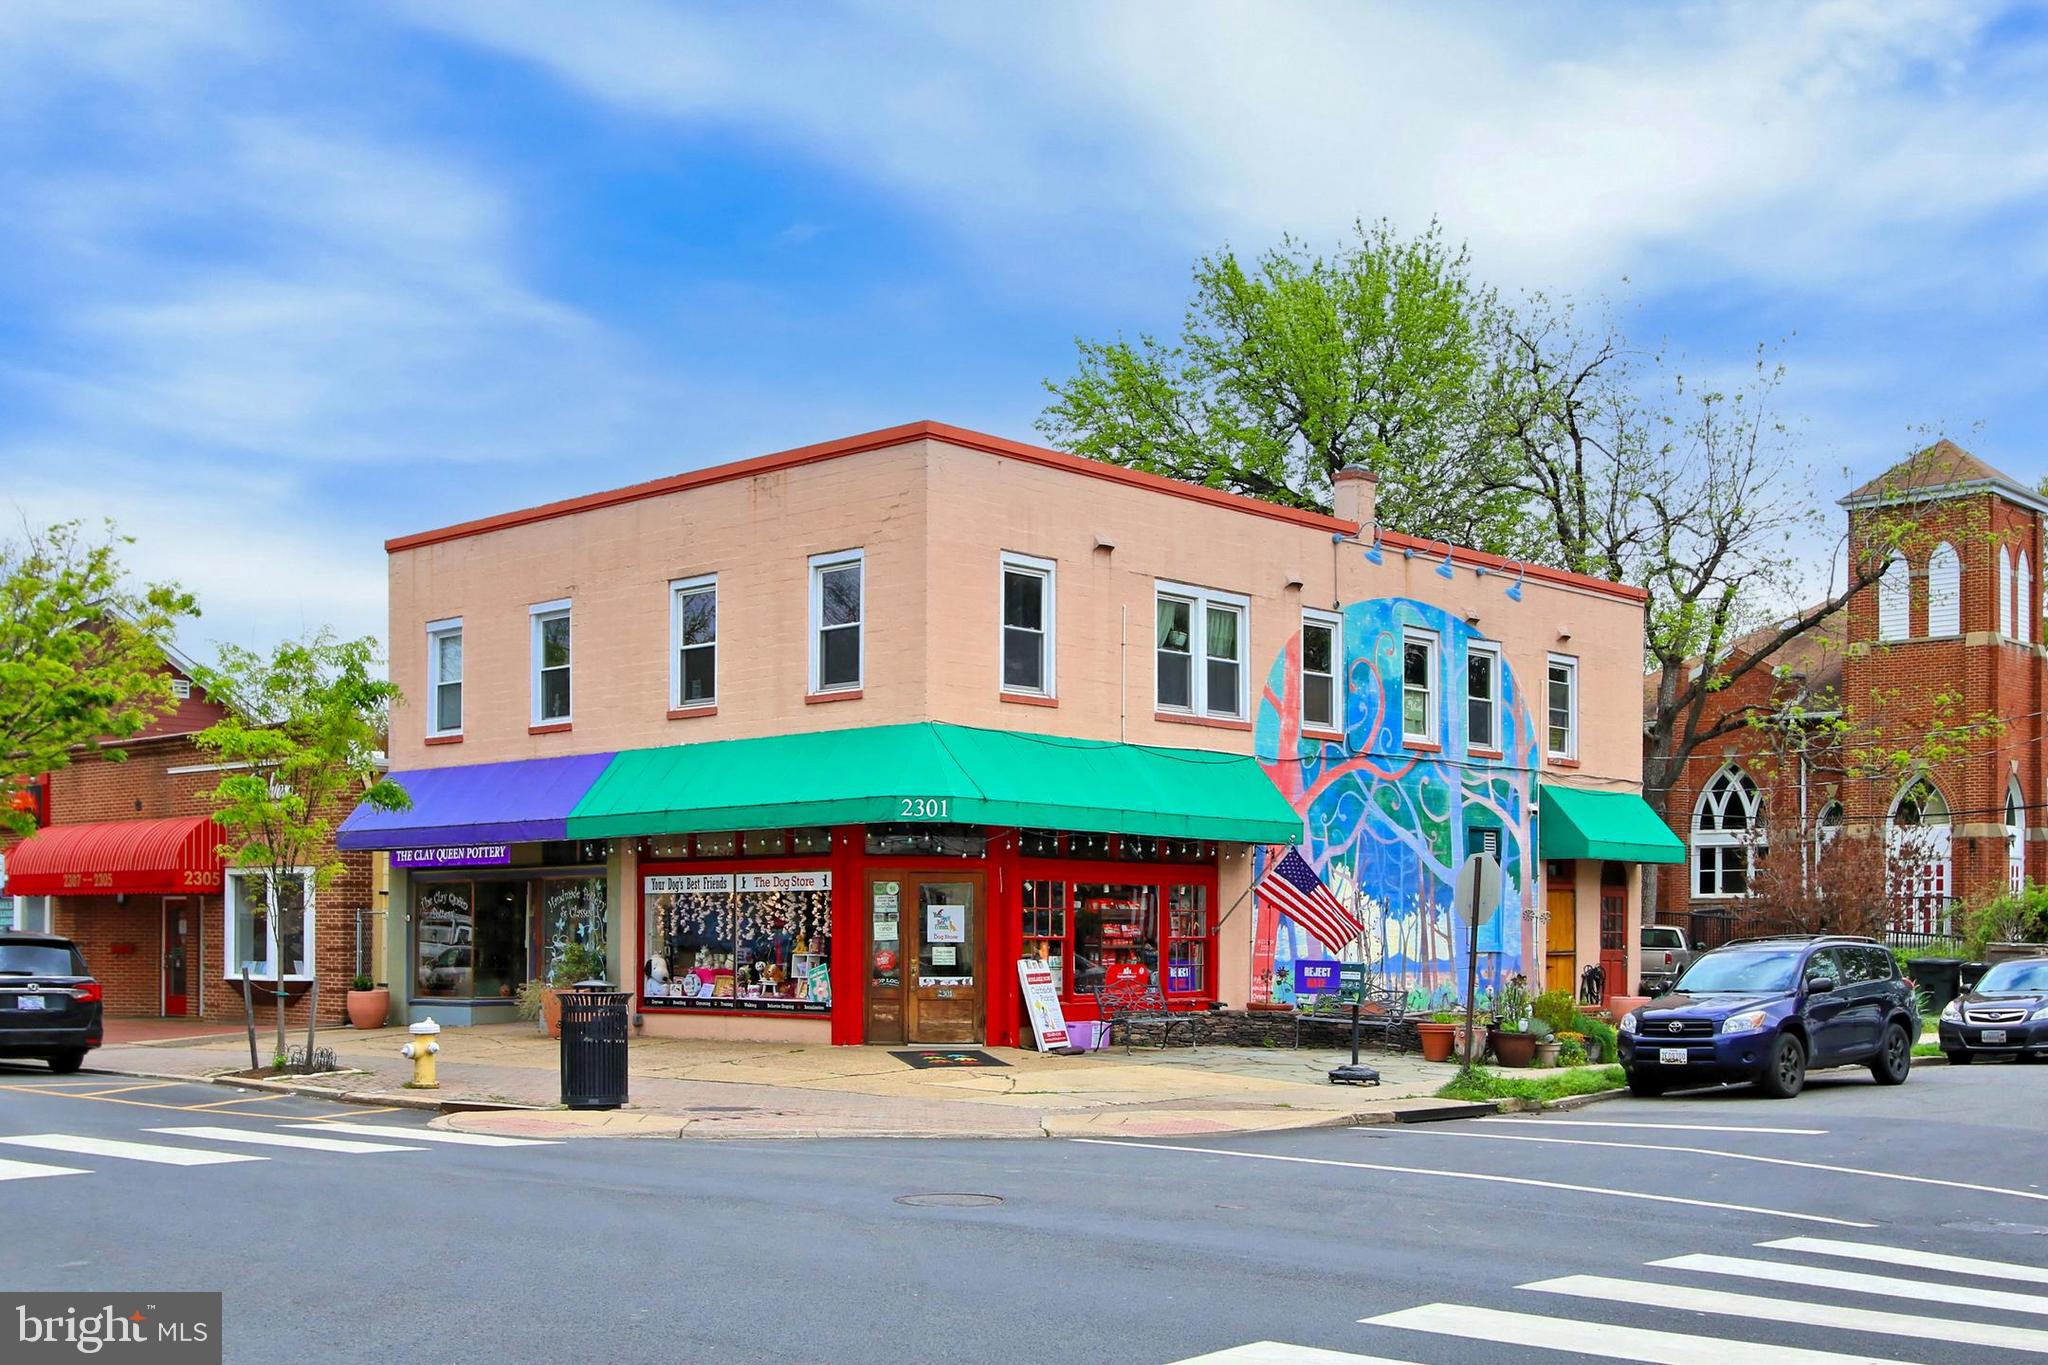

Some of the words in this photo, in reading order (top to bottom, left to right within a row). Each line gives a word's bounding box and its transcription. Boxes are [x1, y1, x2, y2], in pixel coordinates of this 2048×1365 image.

[901, 799, 948, 818] 2301
[396, 850, 412, 862] THE
[413, 849, 435, 861] CLAY
[436, 848, 465, 862] QUEEN
[466, 846, 506, 859] POTTERY
[63, 874, 81, 888] 2307
[94, 873, 113, 887] 2305
[183, 871, 220, 886] 2305
[651, 877, 665, 891] Your
[667, 877, 684, 892] Dog's
[686, 877, 701, 890] Best
[703, 876, 728, 890] Friends
[754, 876, 771, 888] The
[773, 876, 790, 890] Dog
[791, 876, 815, 887] Store
[1304, 966, 1332, 978] REJECT
